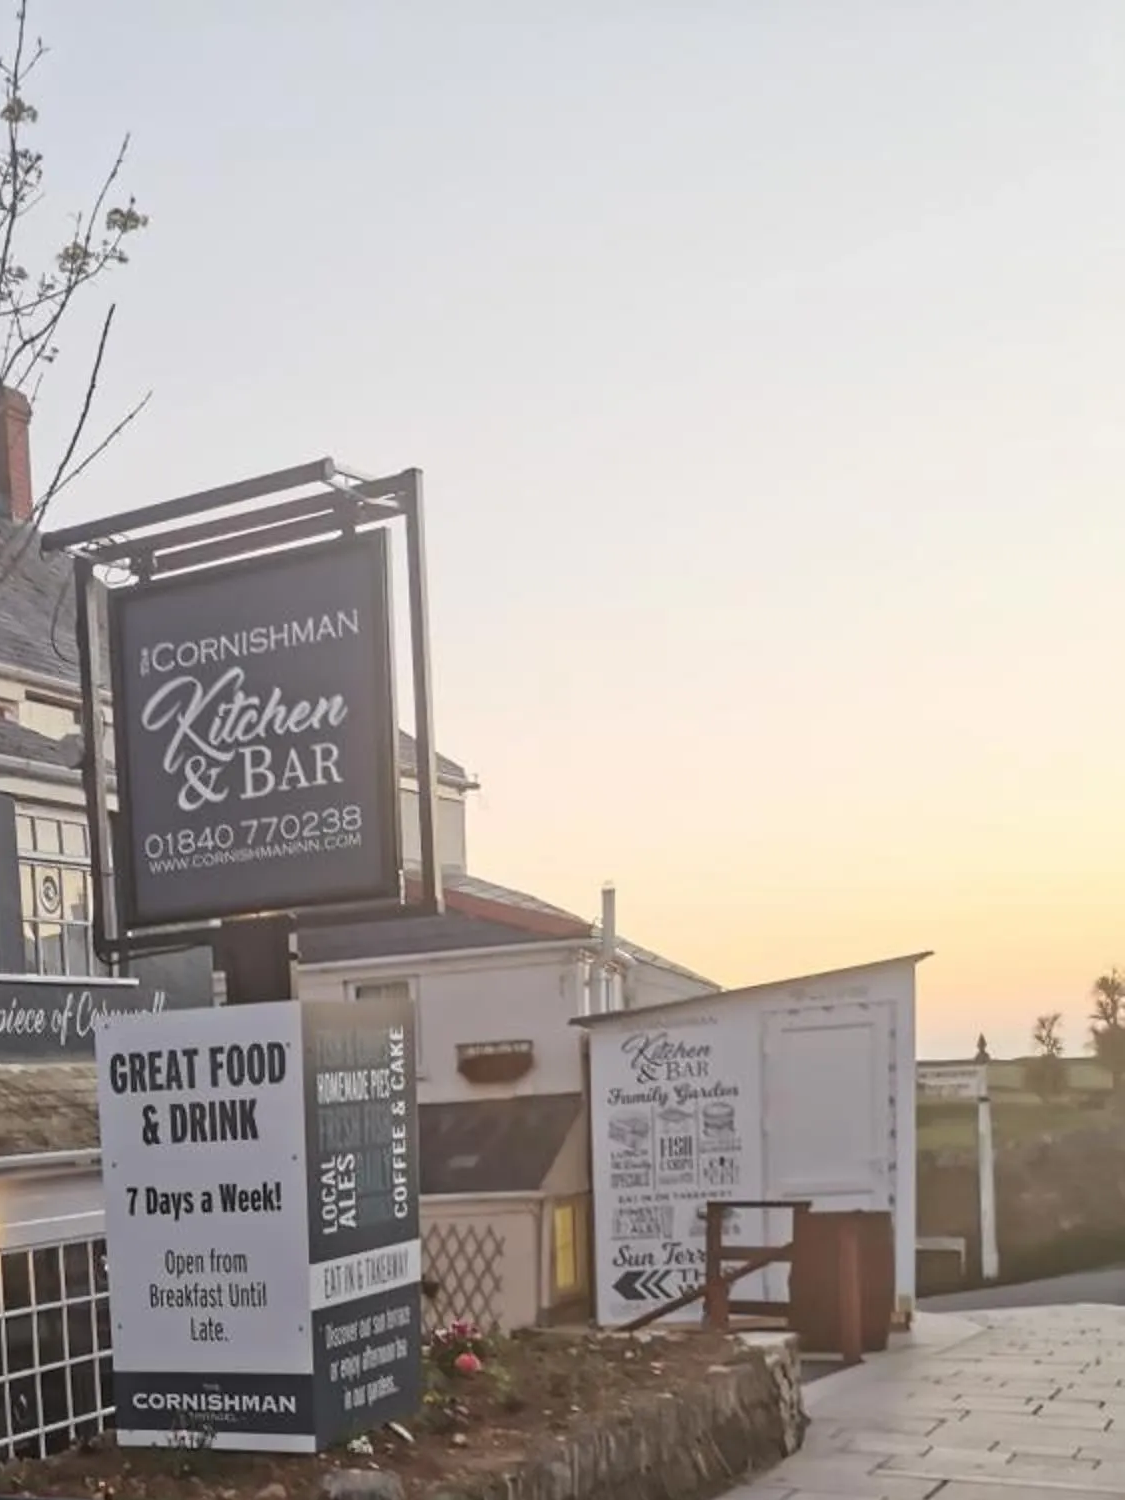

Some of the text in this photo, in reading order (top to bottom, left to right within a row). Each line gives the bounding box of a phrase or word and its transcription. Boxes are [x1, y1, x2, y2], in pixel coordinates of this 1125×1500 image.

[151, 609, 359, 672] CORNISHMAN
[141, 666, 348, 773] Kitchen
[178, 742, 344, 811] & BAR
[145, 805, 362, 859] 01840 770238
[50, 993, 74, 1045] of
[109, 1047, 200, 1095] GREAT
[210, 1042, 287, 1088] FOOD
[621, 1032, 711, 1069] Kitchen
[317, 1069, 370, 1105] HOMEMADE
[636, 1060, 709, 1084] & BAR
[607, 1085, 668, 1107] Family
[142, 1099, 259, 1145] & DRINK
[389, 1024, 409, 1219] COFFEE & CAKE
[126, 1182, 283, 1221] 7 Days a Week!
[321, 1154, 337, 1235] LOCAL
[337, 1153, 357, 1229] ALES
[165, 1248, 248, 1278] Open from
[612, 1242, 706, 1267] Sun Terr
[149, 1281, 268, 1308] Breakfast Until
[190, 1317, 229, 1342] Late.
[132, 1392, 297, 1414] CORNISHMAN
